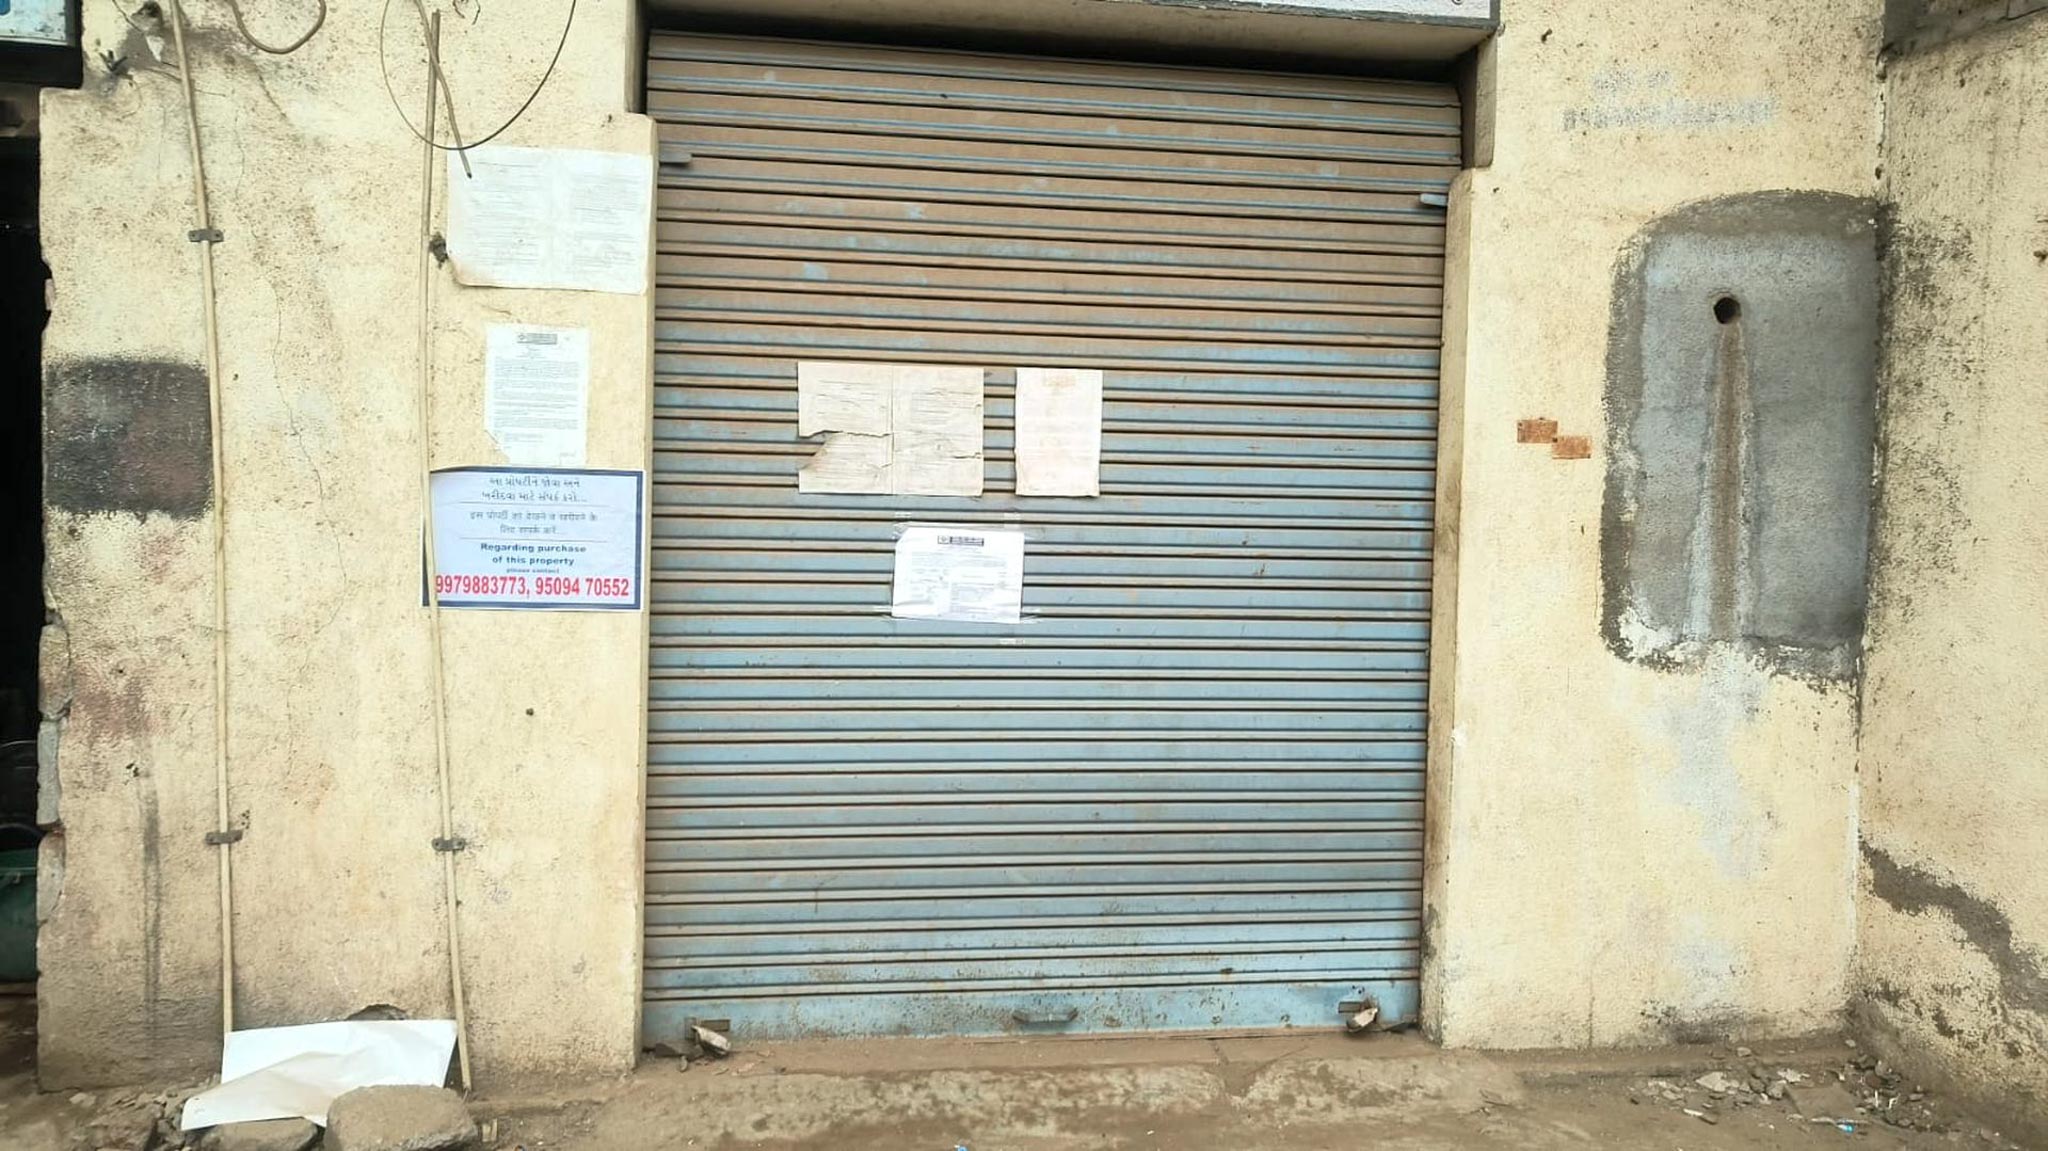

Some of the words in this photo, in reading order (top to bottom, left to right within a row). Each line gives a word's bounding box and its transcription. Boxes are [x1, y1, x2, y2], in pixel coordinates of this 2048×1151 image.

[480, 542, 534, 553] Regarding
[537, 544, 587, 554] purchase
[492, 555, 503, 564] of
[506, 555, 526, 564] this
[529, 557, 575, 567] property
[436, 575, 530, 598] 9979883773,
[535, 577, 580, 596] 95094
[584, 578, 629, 597] 70552
